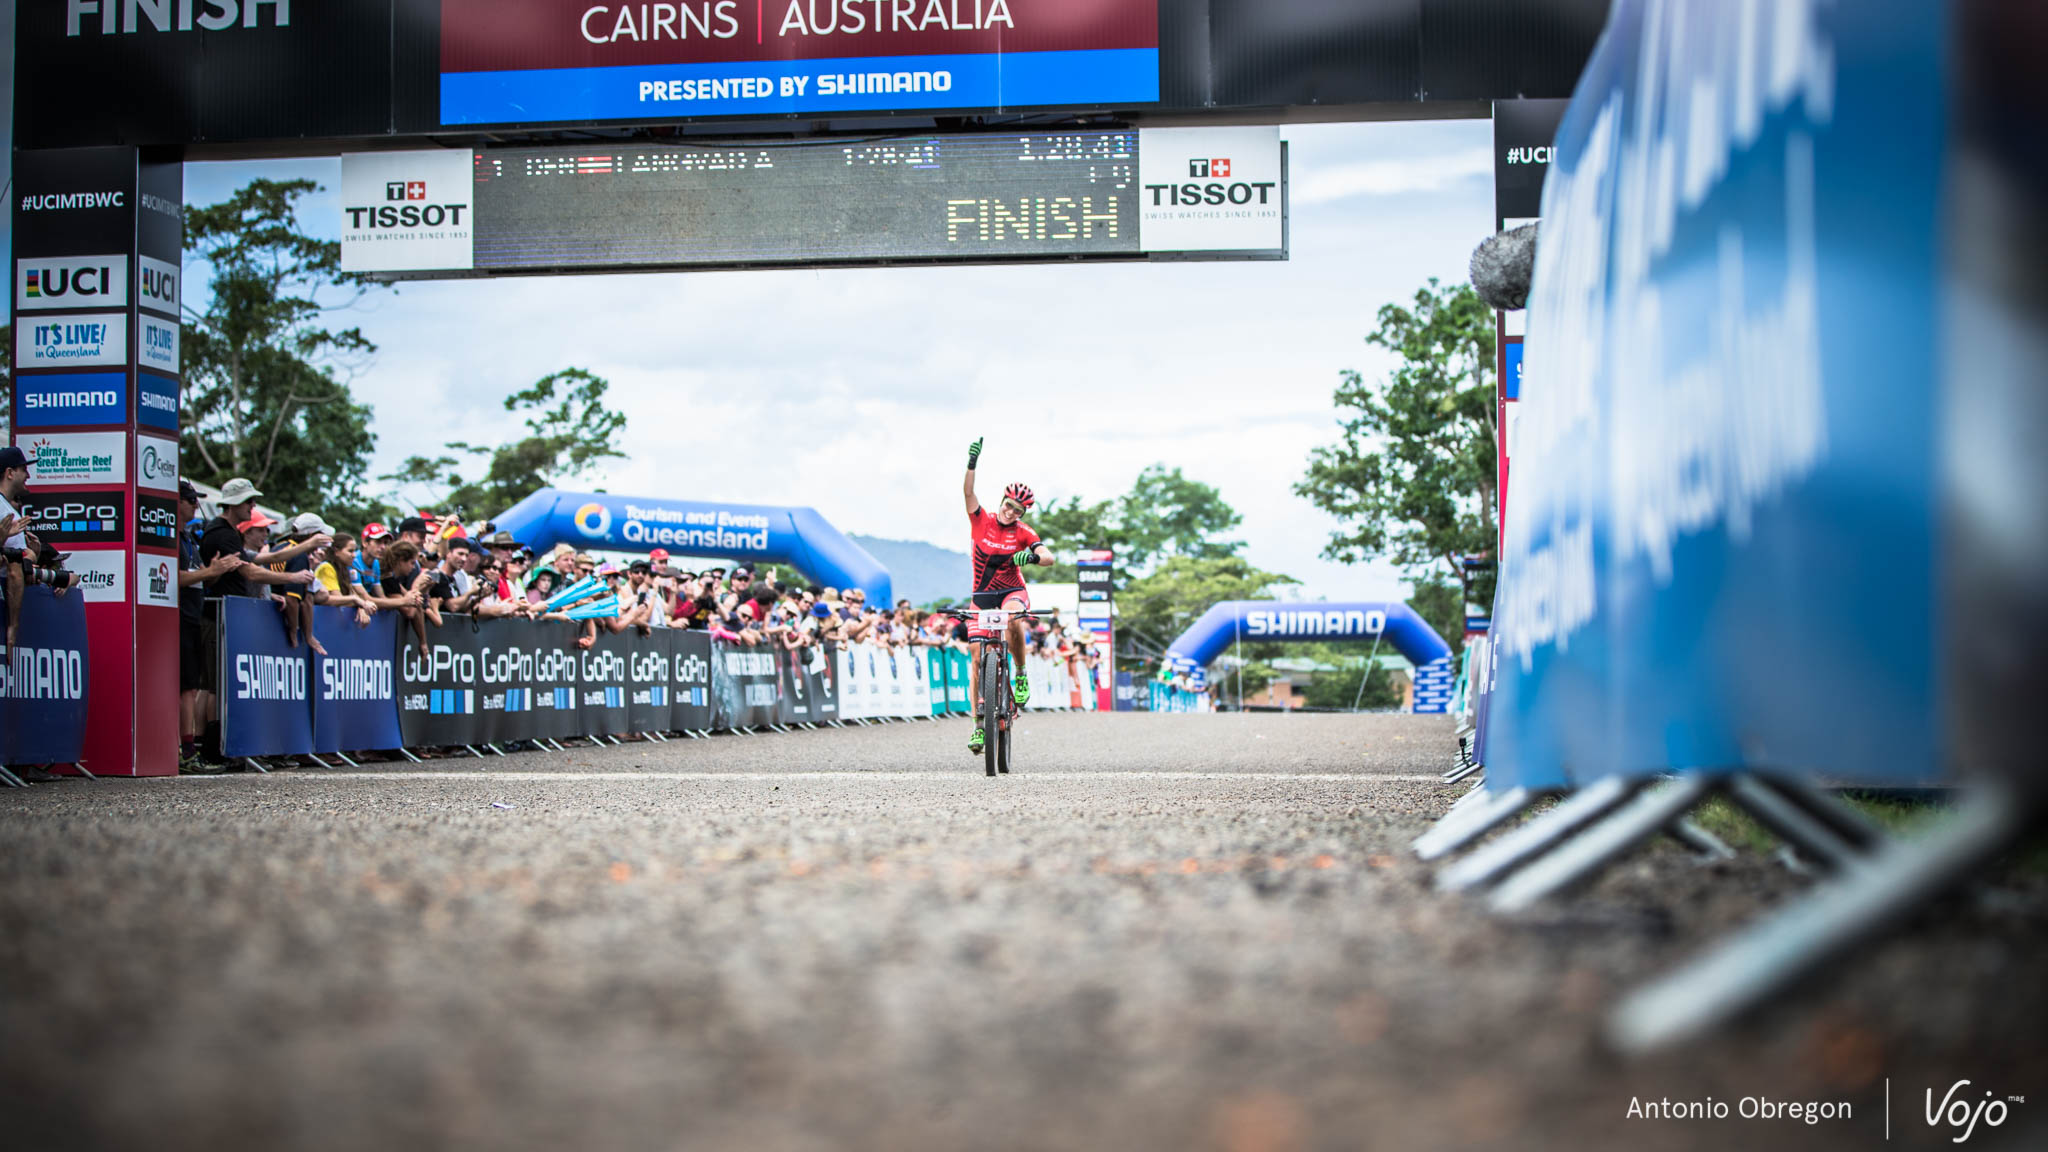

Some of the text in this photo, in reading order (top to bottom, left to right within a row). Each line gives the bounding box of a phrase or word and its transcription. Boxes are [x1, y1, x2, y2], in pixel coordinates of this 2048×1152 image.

[580, 0, 1014, 44] CAIRNS AUSTRALIA
[639, 71, 952, 101] PRESENTED BY SHIMANO
[21, 191, 124, 211] #UCIMTBWC
[1144, 182, 1276, 206] TISSOT
[345, 204, 468, 229] TISSOT
[948, 196, 1118, 242] FINISH
[1144, 212, 1173, 220] SWISS
[1178, 211, 1220, 219] WATCHES
[1225, 210, 1251, 218] SINCE
[345, 234, 371, 242] SWISS
[376, 233, 416, 241] WATCHES
[419, 231, 444, 240] SINCE
[42, 267, 110, 297] UCI
[150, 271, 175, 304] UCI
[66, 324, 107, 346] LIVE!
[36, 344, 101, 360] in Queensland
[25, 391, 118, 408] SHIMANO
[141, 391, 176, 413] SHIMANO
[36, 446, 62, 457] Cairns
[36, 455, 112, 467] Great Barrier Reef
[21, 503, 116, 520] GoPro
[140, 506, 176, 527] GoPro
[624, 504, 769, 528] Tourism and Events
[622, 520, 769, 550] Queensland
[79, 570, 115, 586] cling
[1246, 610, 1386, 635] SHIMANO
[403, 644, 475, 683] GoPro
[481, 647, 533, 683] GoPro
[535, 647, 577, 683] GoPro
[582, 650, 625, 682] GoPro
[631, 651, 669, 683] GoPro
[675, 653, 708, 684] GoPro
[236, 653, 306, 700] SHIMANO
[322, 657, 392, 700] SHIMANO
